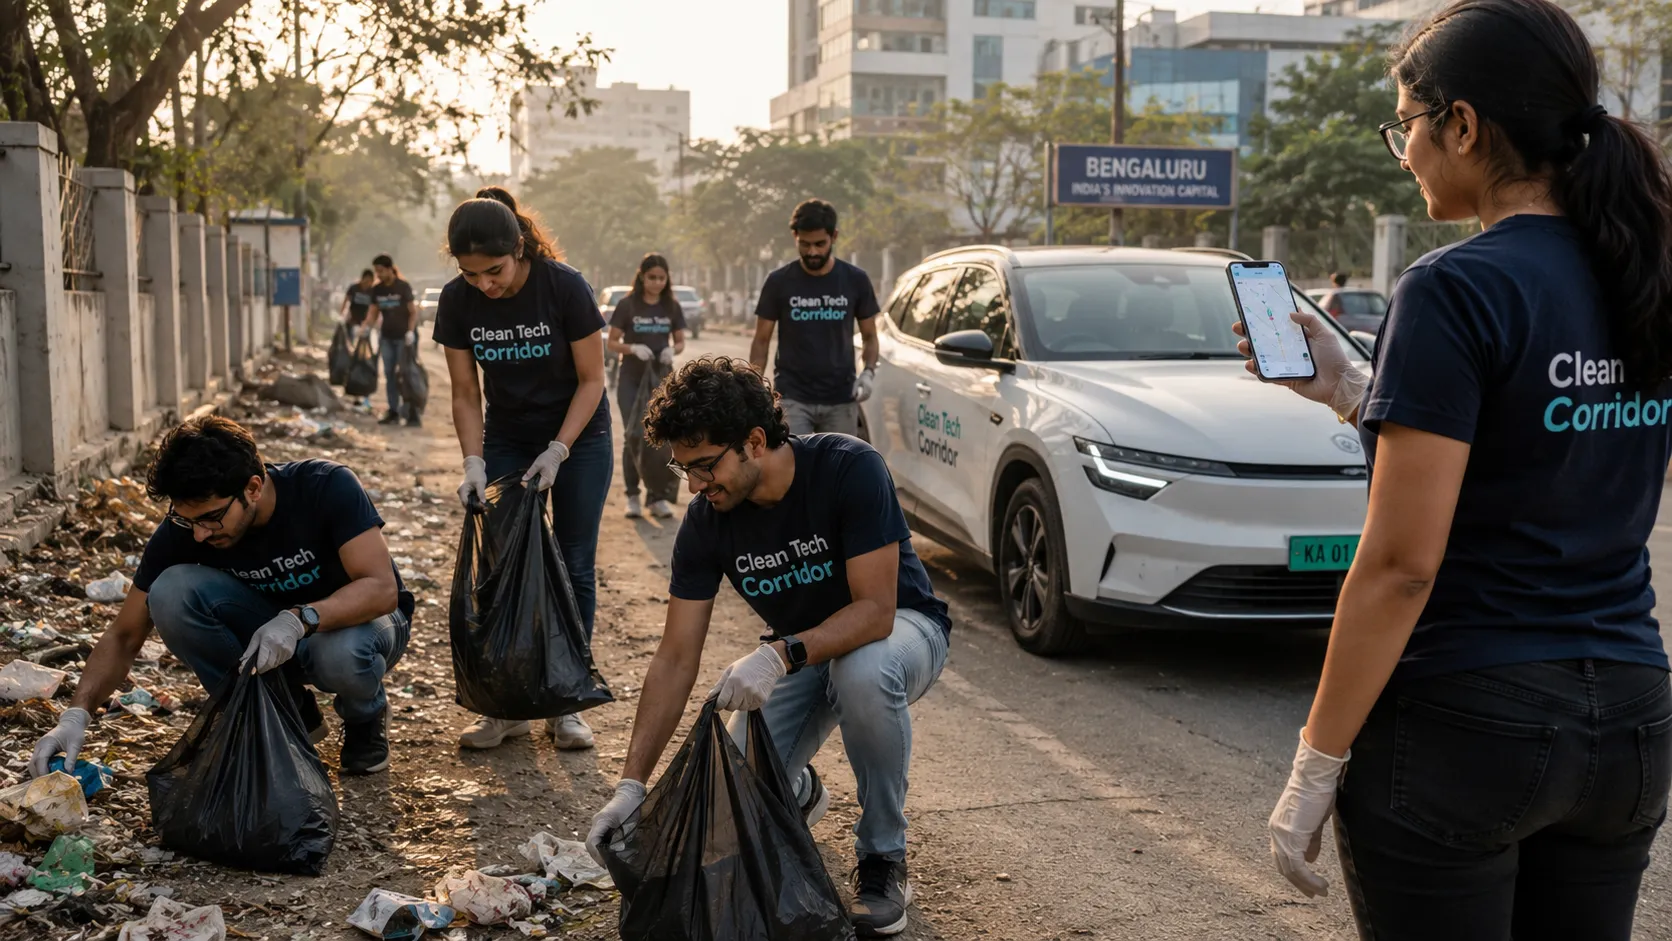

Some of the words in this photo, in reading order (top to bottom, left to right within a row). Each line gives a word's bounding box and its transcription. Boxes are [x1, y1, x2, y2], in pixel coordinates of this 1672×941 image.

[1086, 156, 1207, 180] BENGALURU
[1071, 182, 1111, 196] INDIA'S
[1113, 183, 1175, 198] INNOVATION
[1177, 185, 1219, 198] CAPITAL
[789, 296, 821, 307] Clean
[822, 295, 848, 306] Tech
[791, 307, 847, 321] Corridor
[470, 327, 514, 342] Clean
[516, 321, 551, 339] Tech
[473, 341, 552, 361] Corridor
[1548, 351, 1625, 388] Clean
[918, 404, 940, 430] Clean
[942, 411, 961, 439] Tech
[1543, 391, 1672, 433] Corridor
[918, 430, 959, 468] Corridor
[231, 566, 273, 580] lean
[272, 548, 316, 573] Tech
[735, 552, 790, 573] Clean
[788, 534, 829, 558] Tech
[1304, 544, 1326, 563] KA
[1331, 544, 1349, 563] 01
[249, 565, 321, 592] rridor
[741, 560, 833, 597] Corridor
